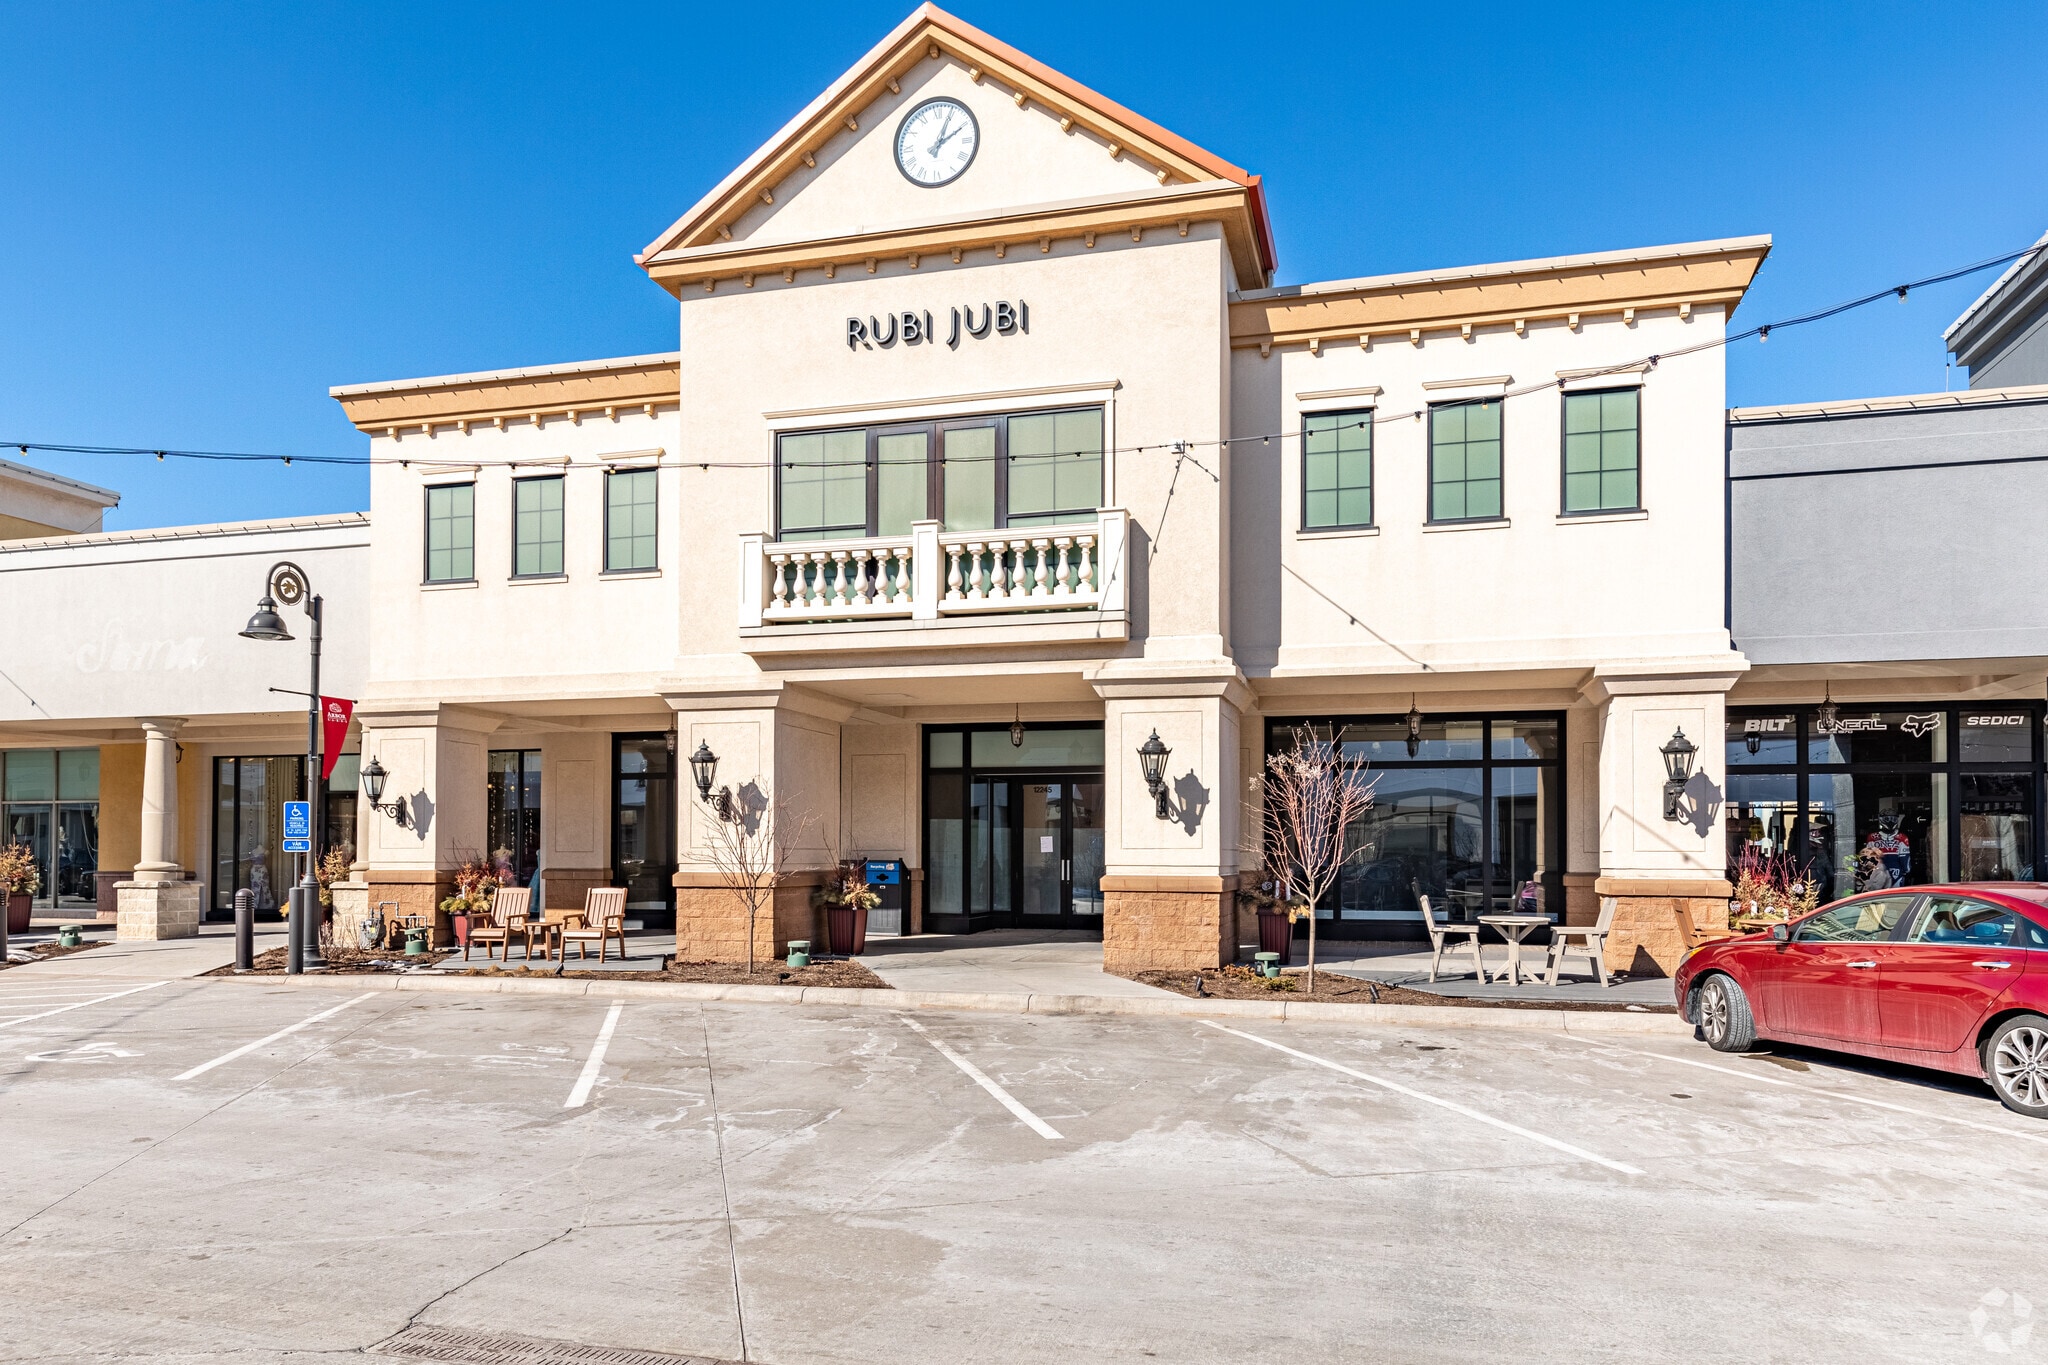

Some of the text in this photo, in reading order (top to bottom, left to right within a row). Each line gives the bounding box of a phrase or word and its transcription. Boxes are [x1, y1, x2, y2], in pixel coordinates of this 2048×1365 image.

[847, 299, 1029, 350] RUBI JUBI
[1744, 719, 1790, 732] BILT
[1967, 715, 2025, 726] SEDICI
[1033, 786, 1053, 794] 12245
